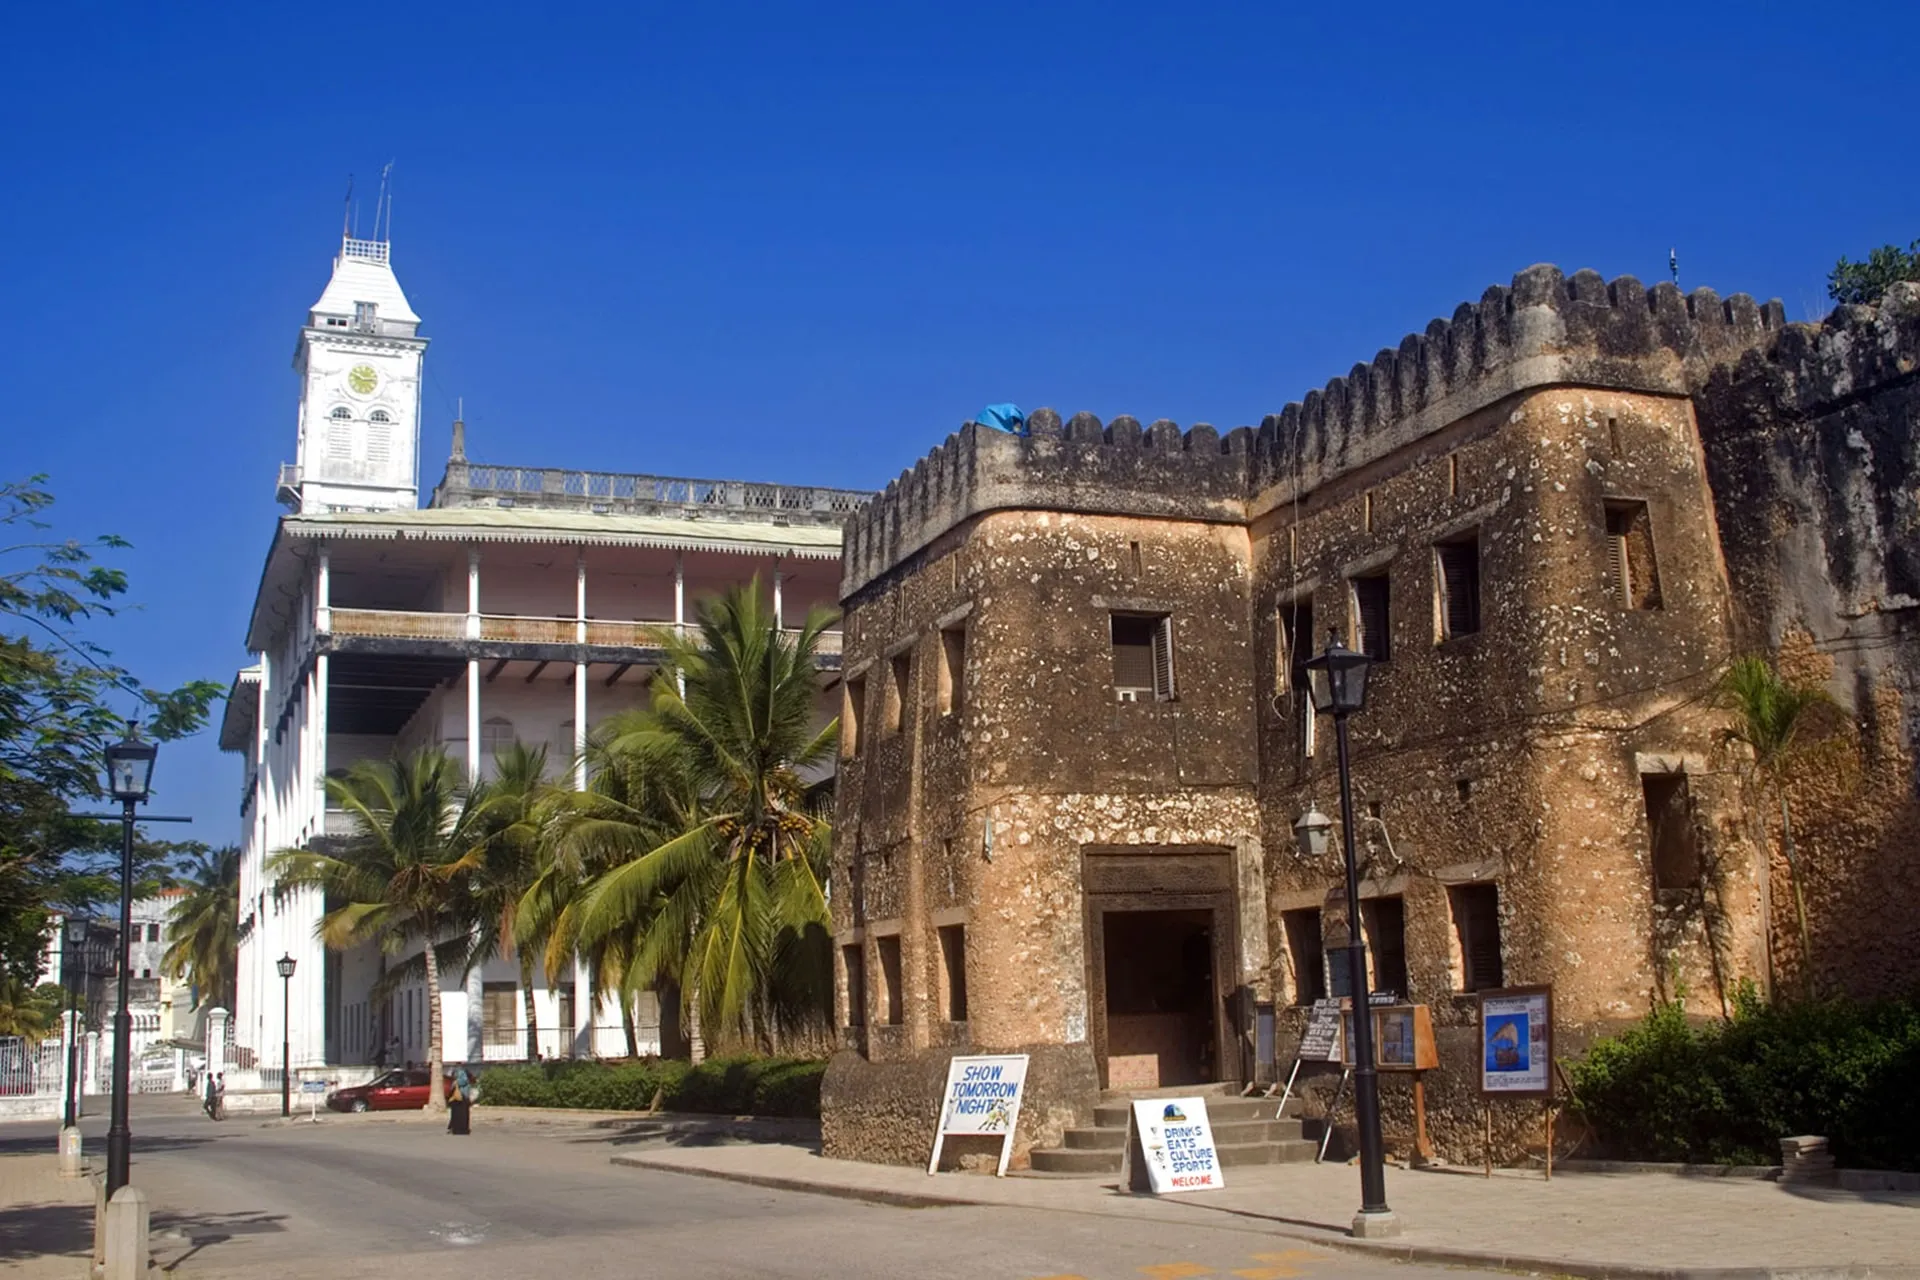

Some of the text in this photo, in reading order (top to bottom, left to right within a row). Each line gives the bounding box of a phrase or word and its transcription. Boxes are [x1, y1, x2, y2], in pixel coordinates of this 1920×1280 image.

[963, 1066, 1003, 1080] SHOW
[953, 1082, 1018, 1097] TOMORROW
[956, 1099, 993, 1114] NIGHT
[1164, 1126, 1202, 1138] DRINKS
[1167, 1138, 1196, 1150] EATS
[1170, 1148, 1213, 1161] CULTURE
[1172, 1160, 1212, 1173] SPORTS
[1171, 1175, 1213, 1187] WELCOME
